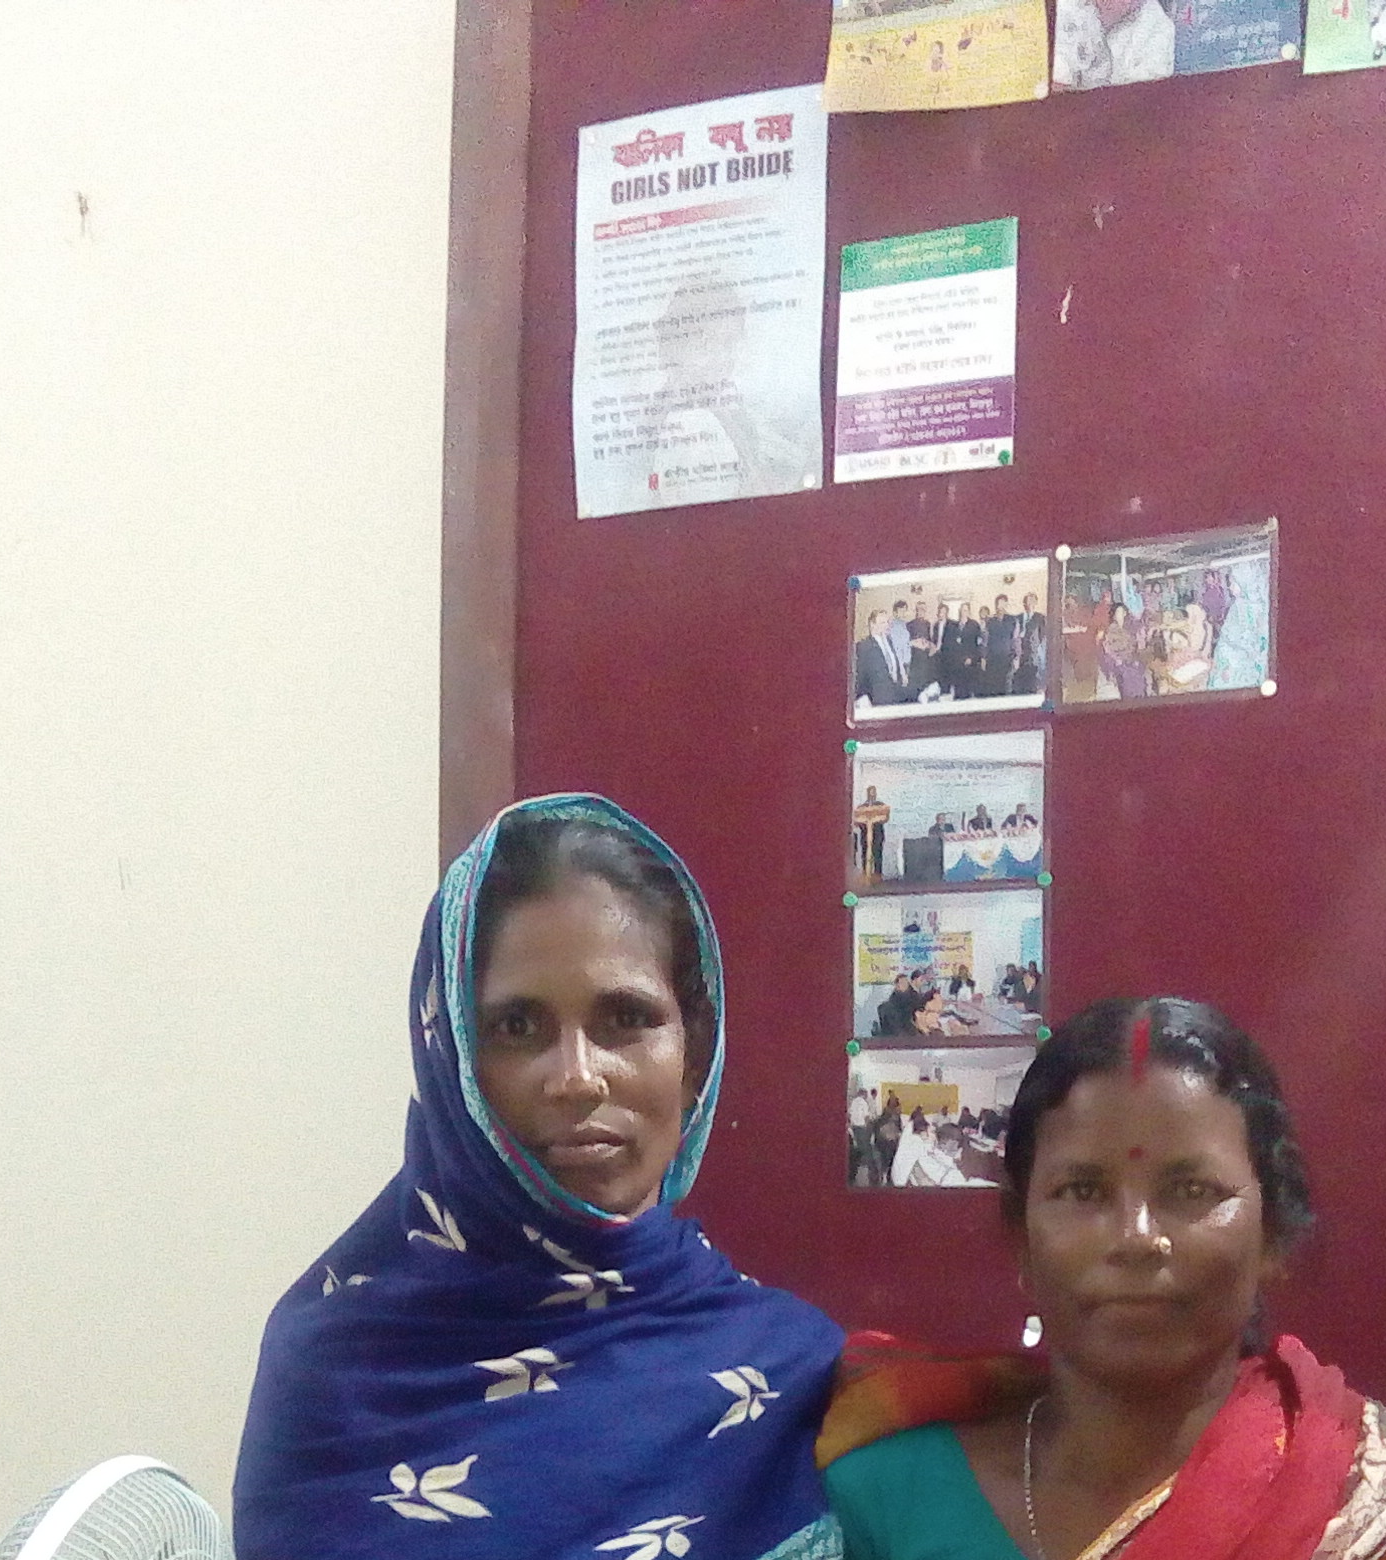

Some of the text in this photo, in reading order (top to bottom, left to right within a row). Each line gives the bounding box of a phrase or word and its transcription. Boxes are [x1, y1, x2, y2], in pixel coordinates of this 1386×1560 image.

[611, 149, 795, 205] GIRLS NOT BRIDE
